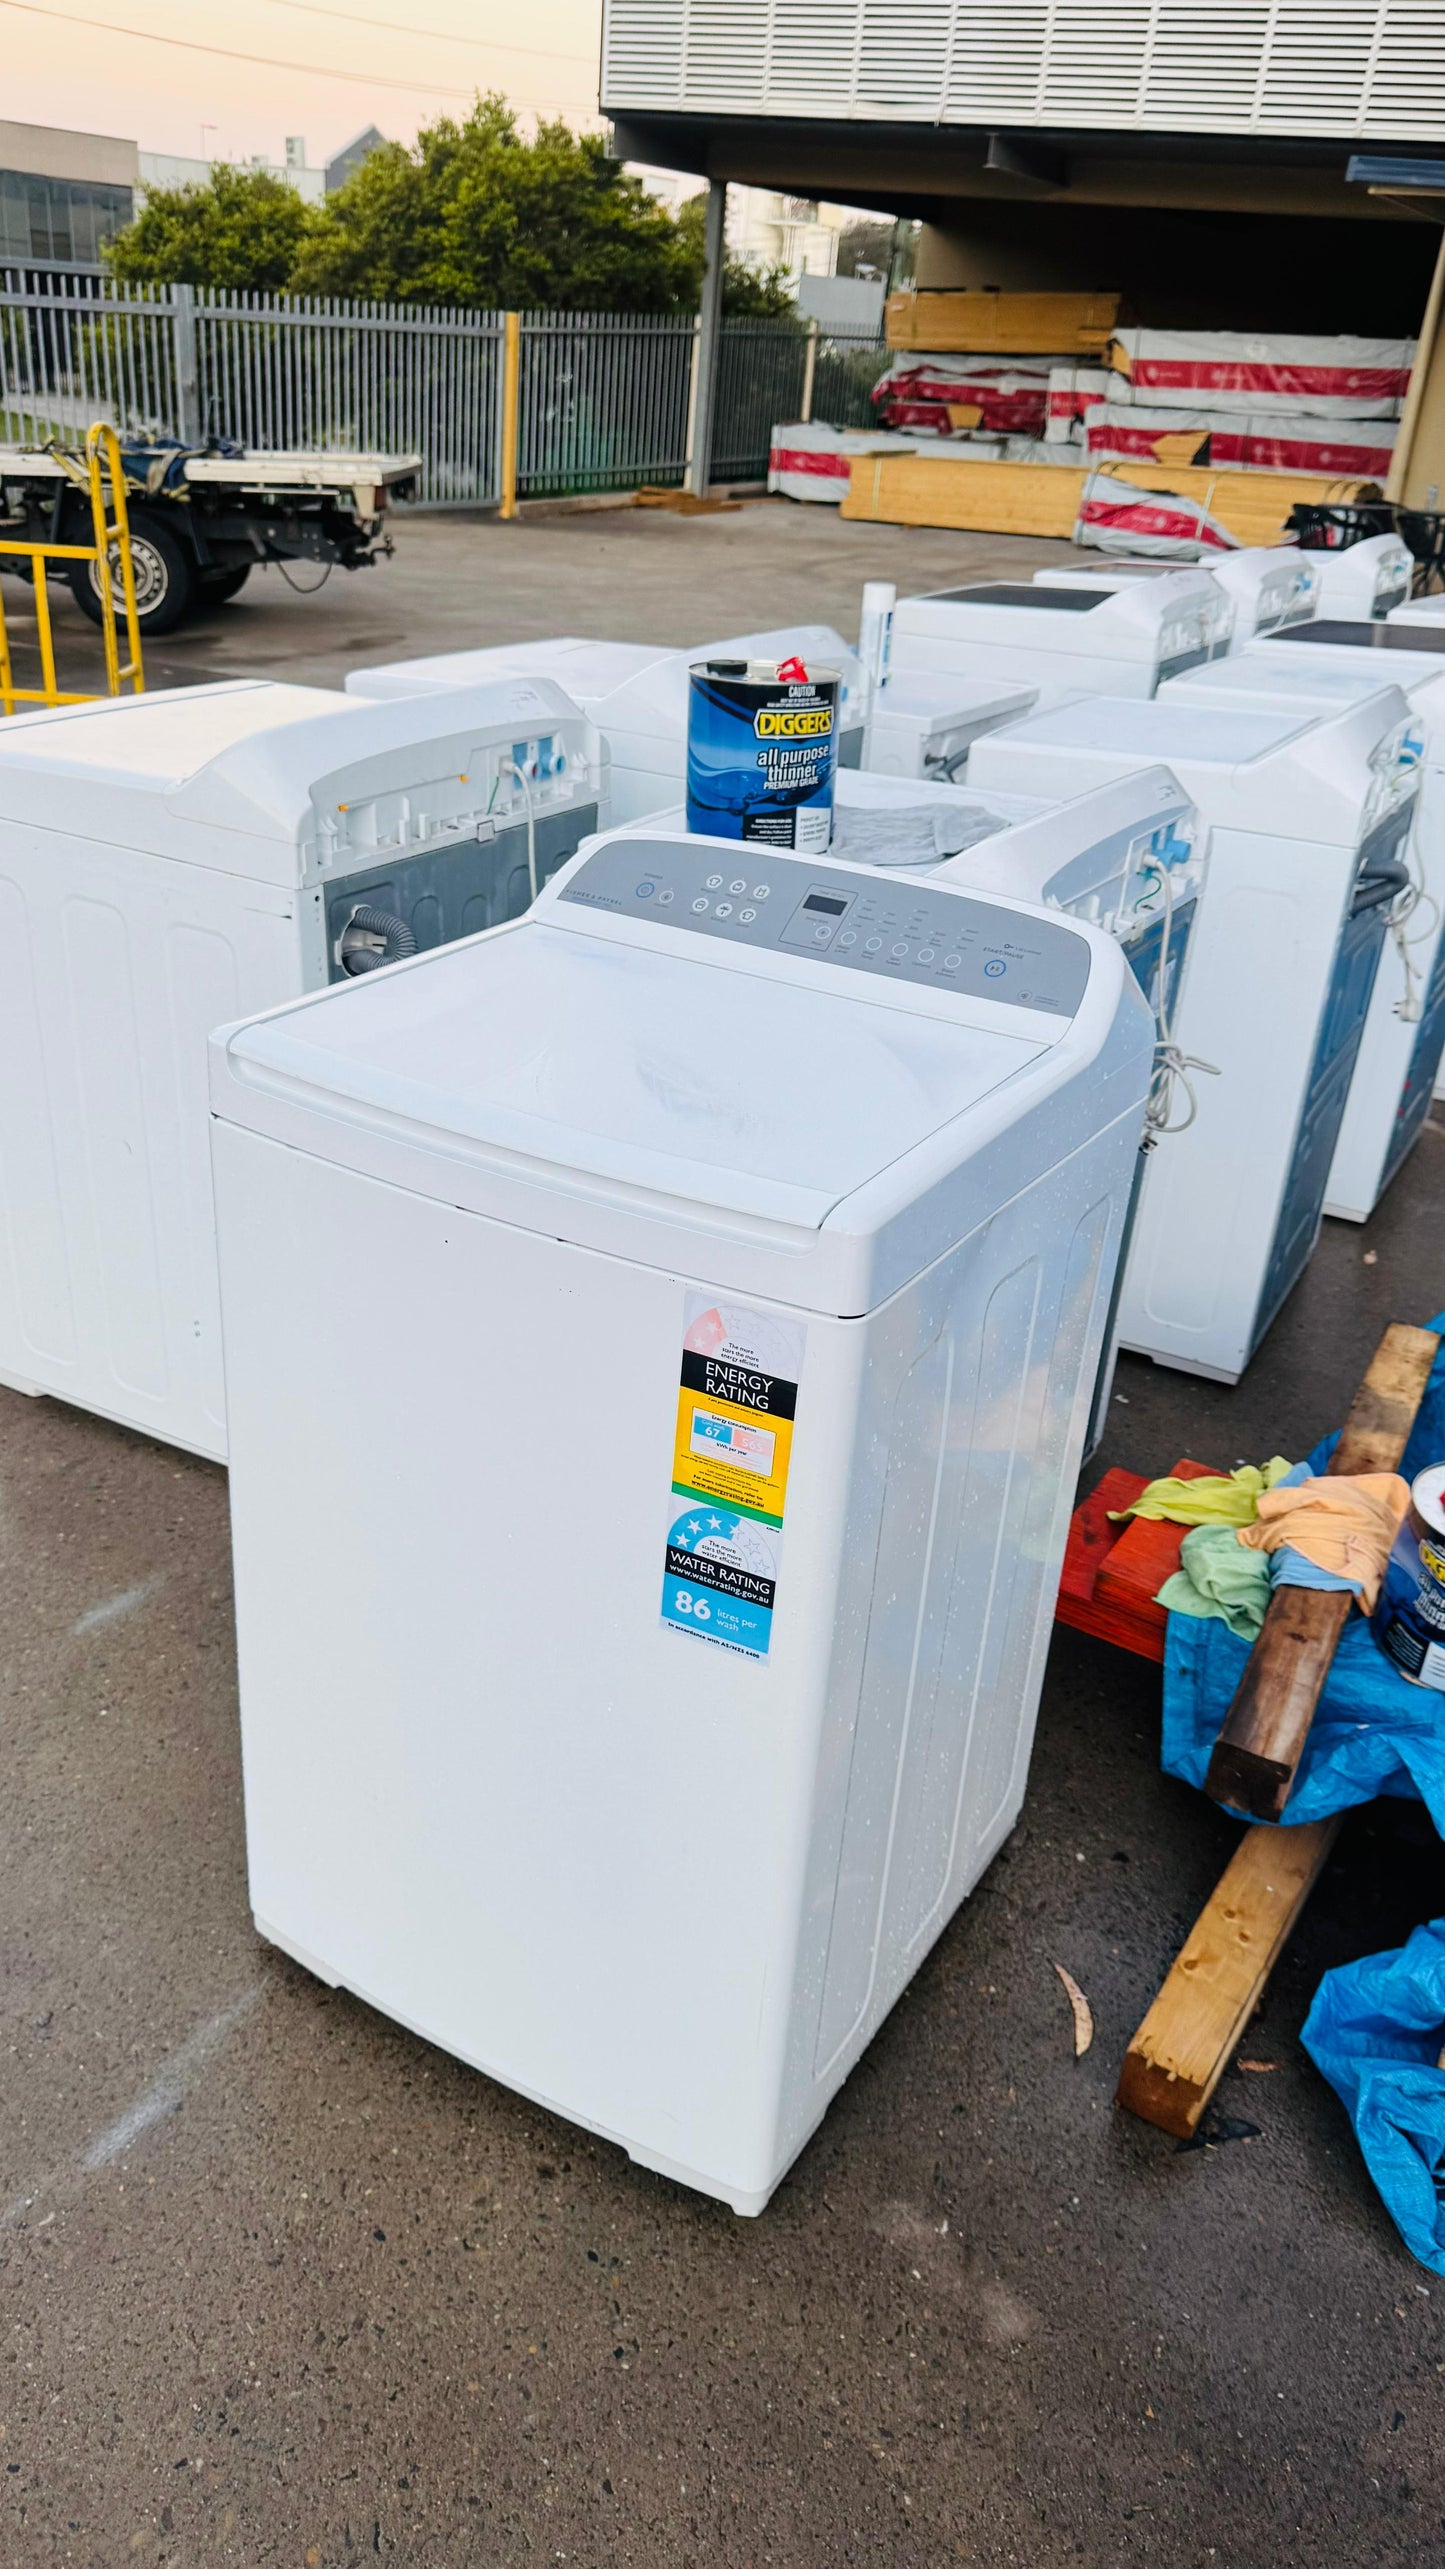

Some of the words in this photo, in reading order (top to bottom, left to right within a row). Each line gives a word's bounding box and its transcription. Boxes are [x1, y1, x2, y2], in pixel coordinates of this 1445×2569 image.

[788, 685, 816, 697] CAUTION
[759, 711, 831, 735] DIGGERS
[758, 748, 778, 765] all
[780, 745, 829, 768] purpose
[768, 765, 817, 781] thinner
[763, 780, 798, 790] PREMIUM
[799, 776, 819, 787] GRADE
[722, 1347, 735, 1356] stars
[745, 1354, 759, 1362] more
[729, 1343, 739, 1351] The
[740, 1346, 754, 1355] more
[721, 1354, 738, 1362] energy
[740, 1358, 759, 1368] efficient
[705, 1361, 773, 1393] ENERGY
[706, 1378, 769, 1409] RATING
[705, 1426, 720, 1437] 67
[712, 1415, 727, 1424] Energy
[728, 1421, 757, 1432] consumption
[716, 1442, 728, 1450] kWh
[702, 1544, 715, 1553] stars
[716, 1548, 726, 1557] the
[727, 1553, 742, 1562] more
[708, 1540, 720, 1549] The
[721, 1545, 736, 1554] more
[702, 1551, 718, 1560] water
[719, 1555, 741, 1567] efficient
[670, 1550, 715, 1577] WATER
[719, 1569, 770, 1595] RATING
[669, 1563, 769, 1604] www.waterrating.gov.au
[675, 1590, 711, 1620] 86
[716, 1618, 739, 1632] wash
[717, 1609, 739, 1623] litres
[741, 1618, 757, 1629] per
[675, 1625, 706, 1639] accordance
[707, 1637, 720, 1645] with
